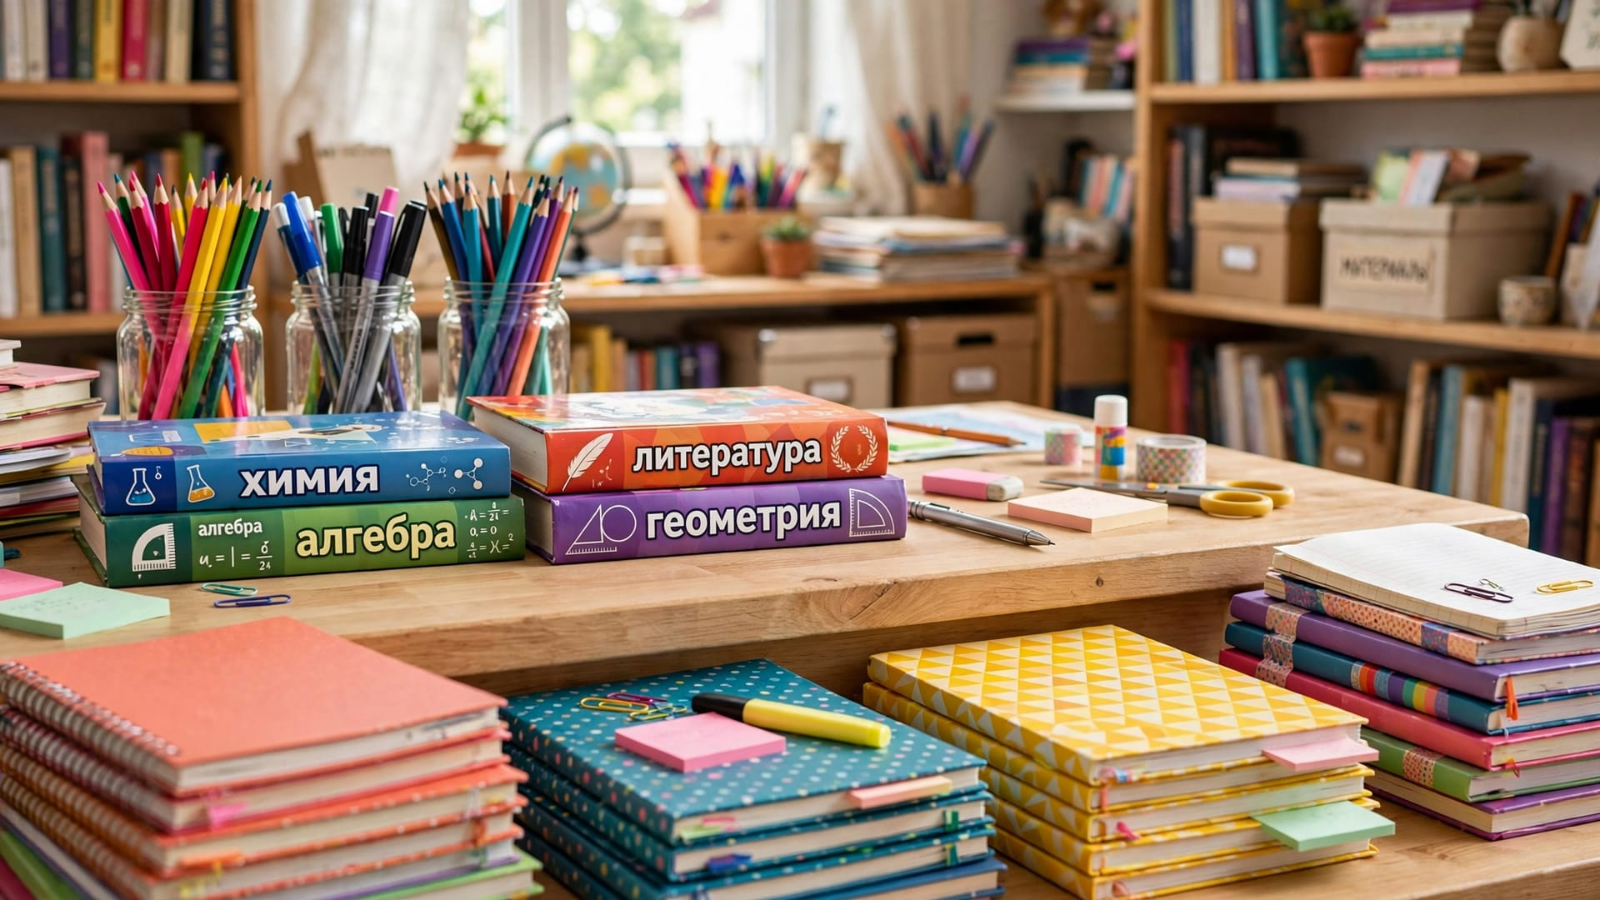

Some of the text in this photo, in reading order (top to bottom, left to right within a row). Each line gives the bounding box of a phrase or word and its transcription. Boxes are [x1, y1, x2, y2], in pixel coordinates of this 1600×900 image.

[632, 440, 822, 476] литература
[240, 465, 379, 498] химия
[198, 517, 263, 538] алгебра
[296, 513, 456, 559] алгебра
[646, 501, 841, 539] геометрия
